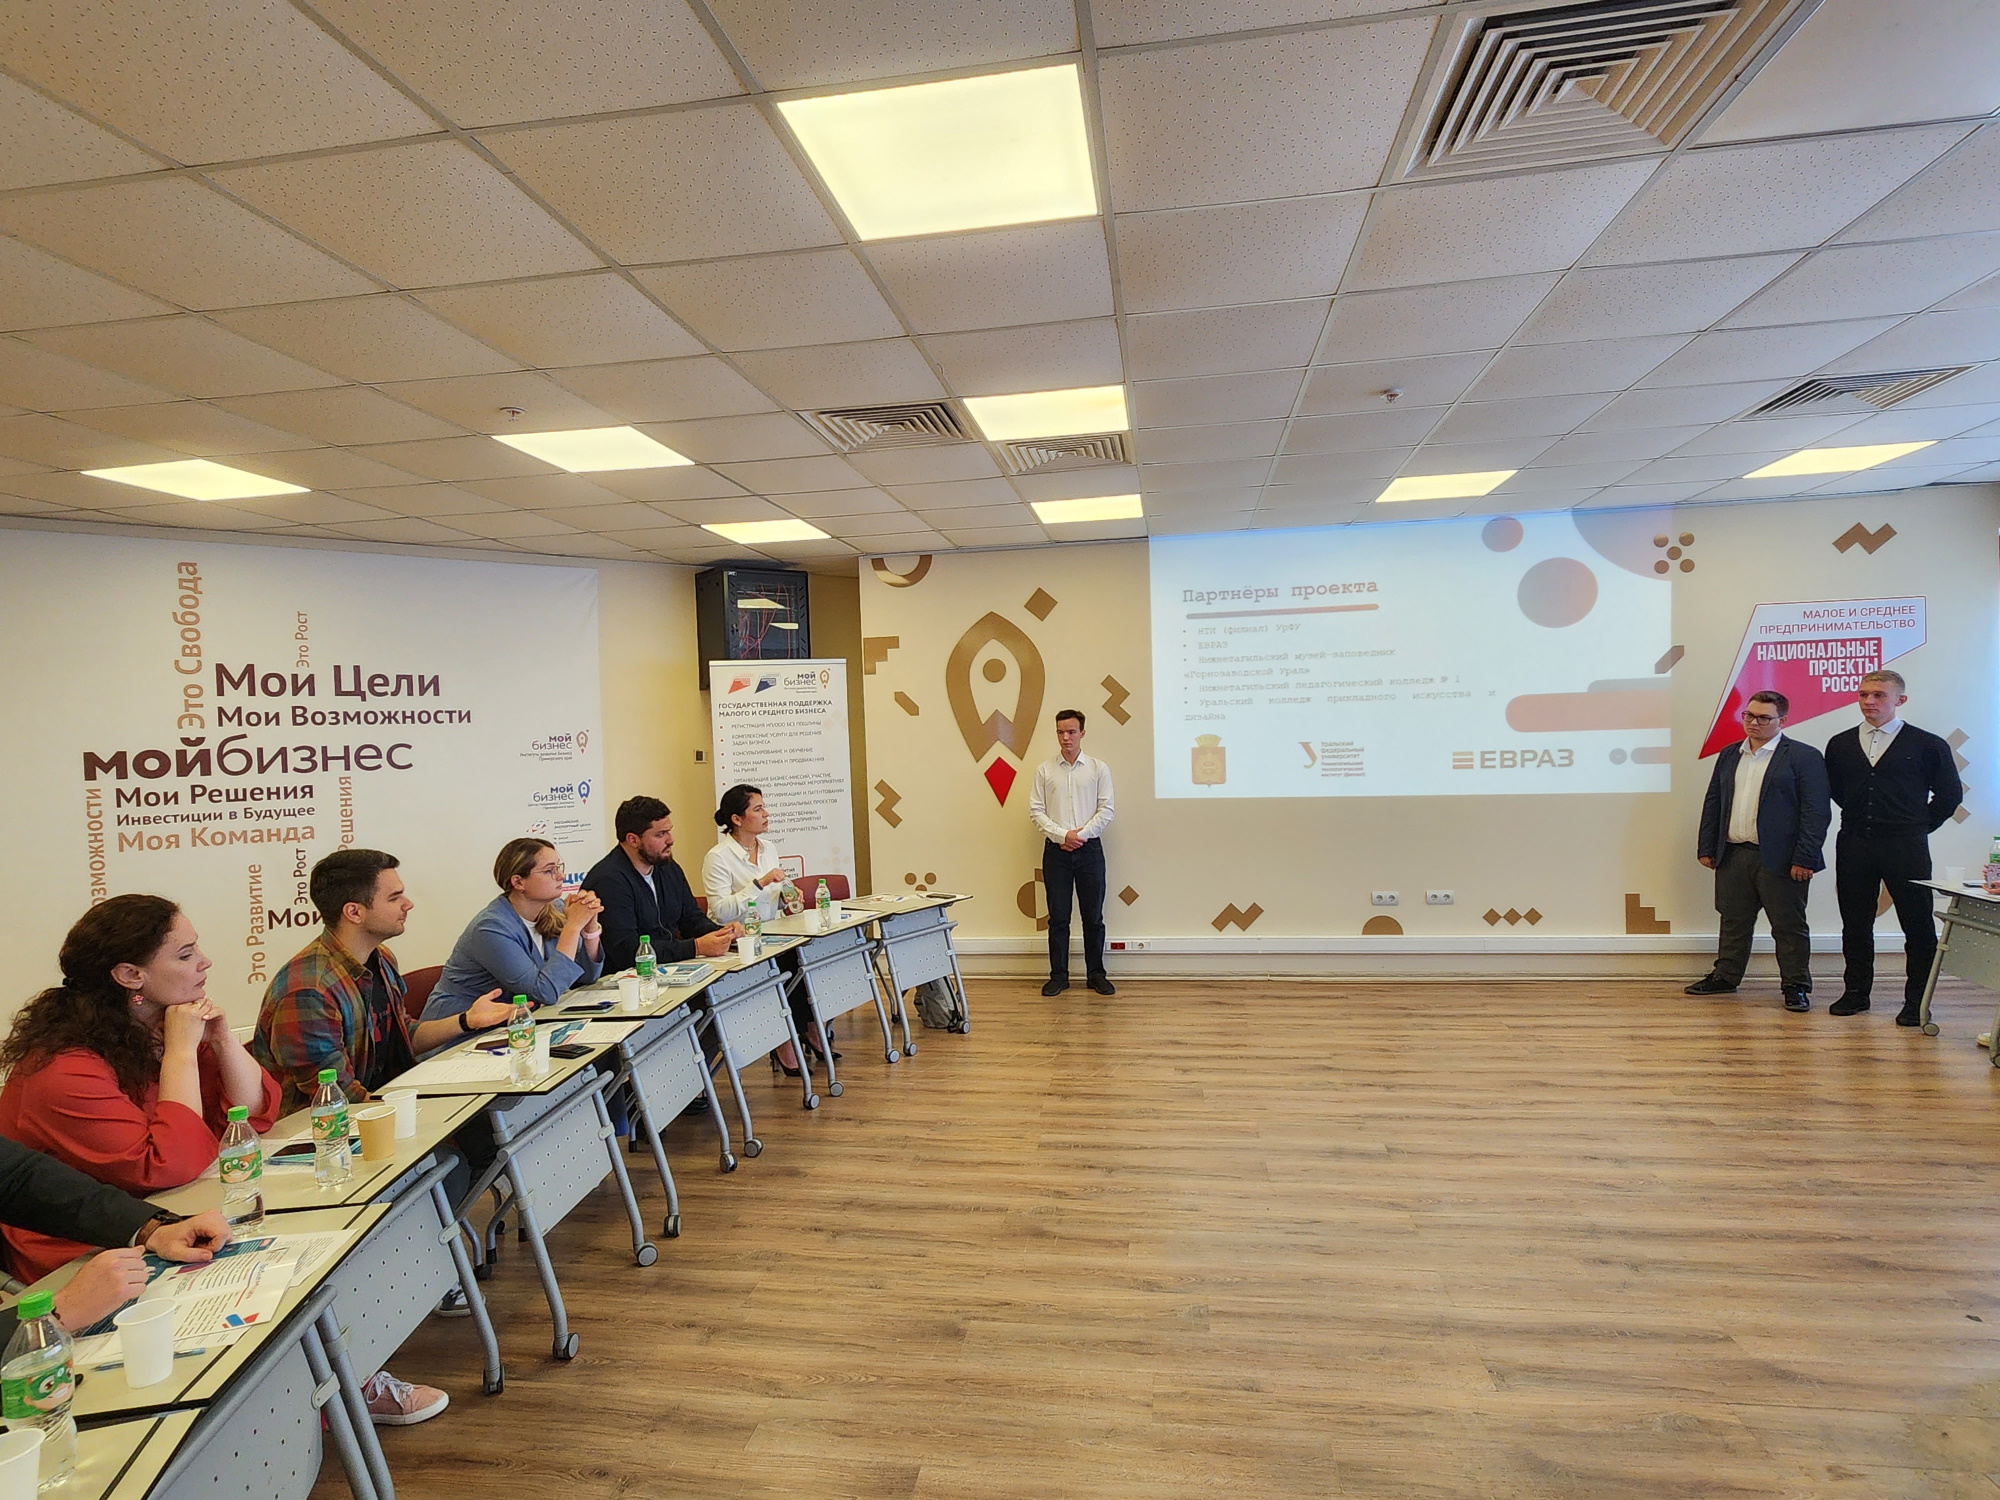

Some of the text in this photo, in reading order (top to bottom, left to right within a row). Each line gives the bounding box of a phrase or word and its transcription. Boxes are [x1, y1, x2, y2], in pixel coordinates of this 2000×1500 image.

[1182, 581, 1379, 605] Партнёры проекта
[1802, 604, 1916, 620] МАЛОЕ И СРЕДНЕЕ
[1759, 618, 1917, 636] ПРЕДПРИНИМАТЕЛЬСТВО
[171, 561, 206, 730] Это Свобода
[294, 610, 310, 669] Это Рост
[1198, 640, 1229, 650] ЕВРАЗ
[1757, 640, 1879, 662] НАЦИОНАЛЬНЫЕ
[797, 671, 816, 679] мой
[1808, 657, 1880, 677] ПРОЕКТЫ
[214, 662, 441, 702] Мои Цели
[783, 677, 817, 686] бизнес
[1822, 675, 1862, 693] РОСС
[718, 699, 833, 710] ГОСУДАРСТВЕННАЯ ПОДДЕРЖКА
[758, 708, 794, 716] СРЕДНЕГО
[795, 707, 827, 715] БИЗНЕСА
[217, 705, 472, 728] Мои Возможности
[531, 740, 573, 750] бизнес
[549, 733, 572, 743] мой
[1480, 748, 1575, 769] ЕВРАЗ
[115, 784, 314, 809] Мои Решения
[533, 791, 575, 803] бизнес
[550, 783, 574, 794] мой
[116, 806, 316, 827] Инвестиции в Будущее
[117, 825, 316, 853] Моя Команда
[293, 848, 308, 906] Это Рост
[246, 864, 267, 985] Это Развитие
